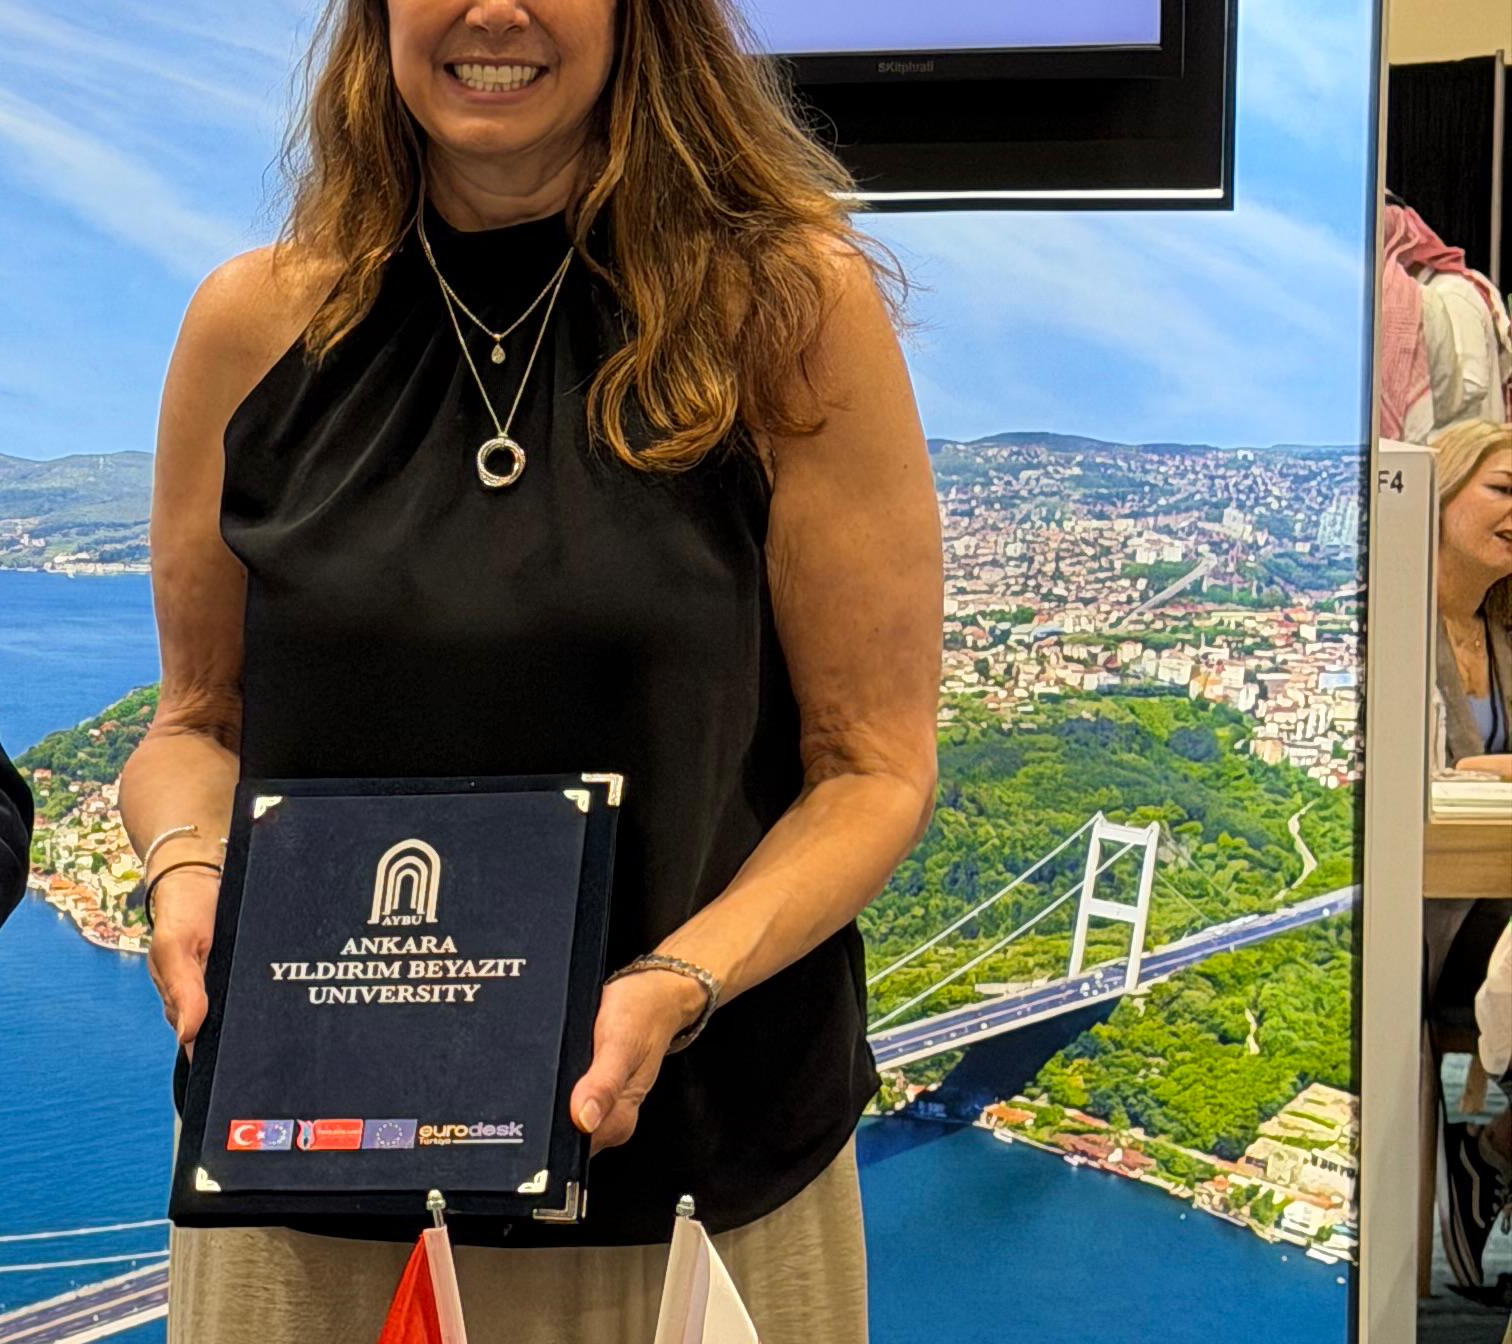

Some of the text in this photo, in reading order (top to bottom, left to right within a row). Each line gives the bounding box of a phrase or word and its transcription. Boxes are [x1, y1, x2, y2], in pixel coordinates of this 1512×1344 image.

[1378, 470, 1404, 494] F4
[381, 914, 423, 926] AYBU
[339, 935, 458, 955] ANKARA
[270, 958, 527, 981] YILDIRIM BEYAZIT
[308, 983, 482, 1005] UNIVERSITY
[418, 1121, 524, 1137] eurodesk
